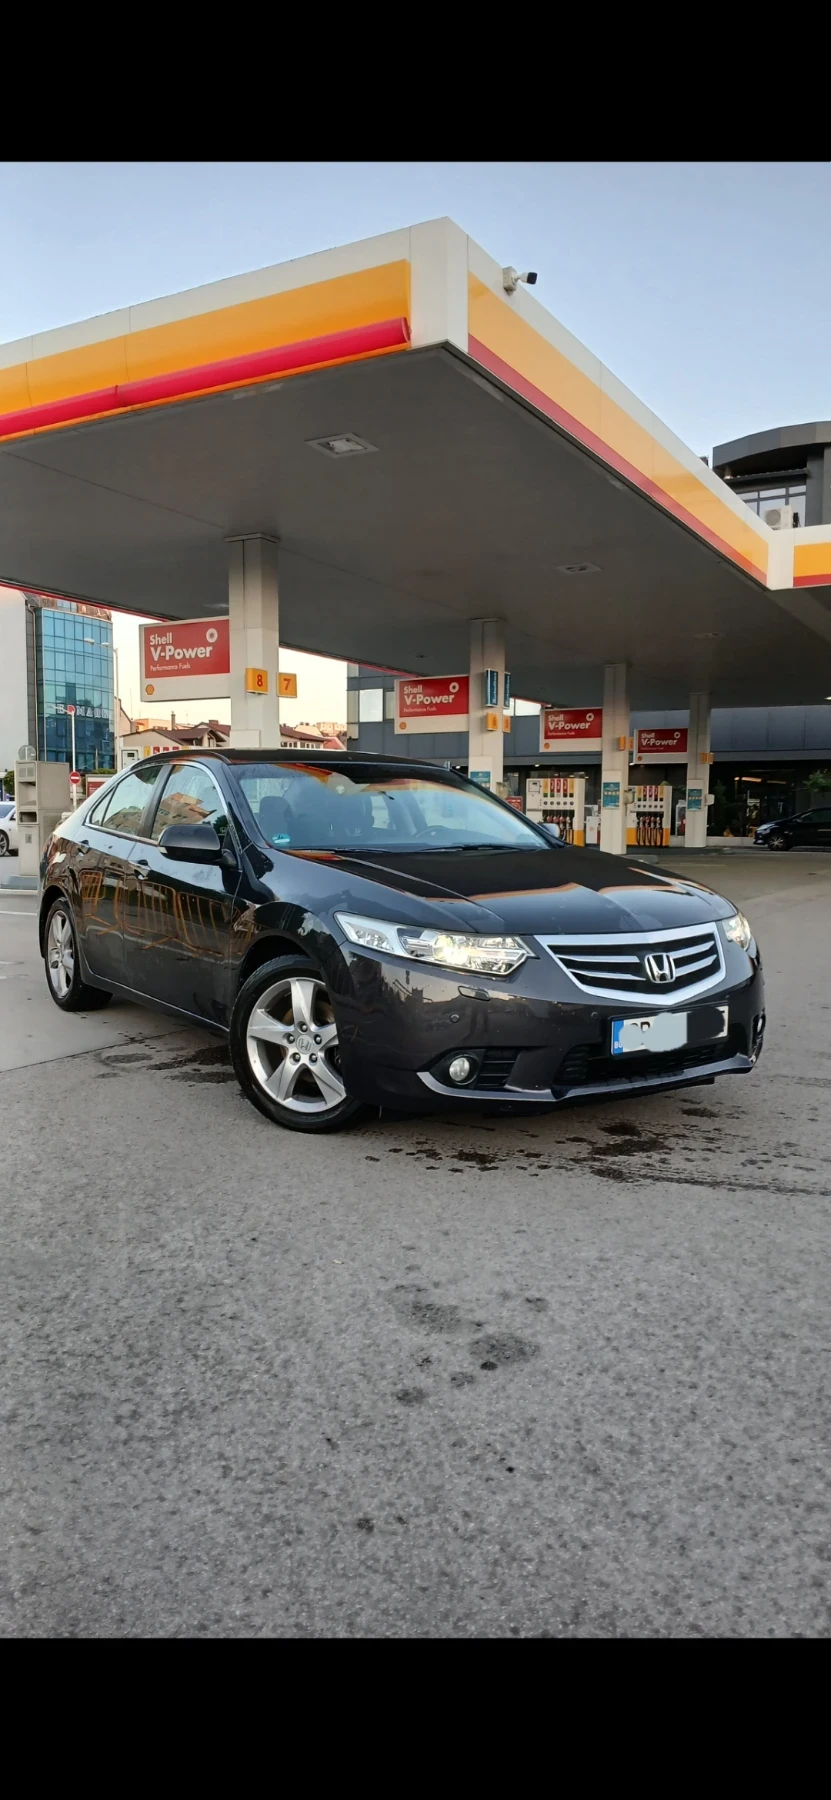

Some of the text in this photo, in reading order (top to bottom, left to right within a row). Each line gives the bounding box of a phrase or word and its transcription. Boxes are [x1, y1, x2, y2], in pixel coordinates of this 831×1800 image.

[150, 632, 172, 645] Shell
[150, 645, 213, 661] V-Power
[150, 662, 191, 672] Performance Fuels
[257, 674, 263, 687] 8
[283, 678, 291, 690] 7
[403, 684, 423, 694] Shell
[404, 694, 455, 706] V-Power
[548, 714, 564, 722] Shell
[548, 721, 591, 730] V-Power
[641, 738, 678, 746] V-Power
